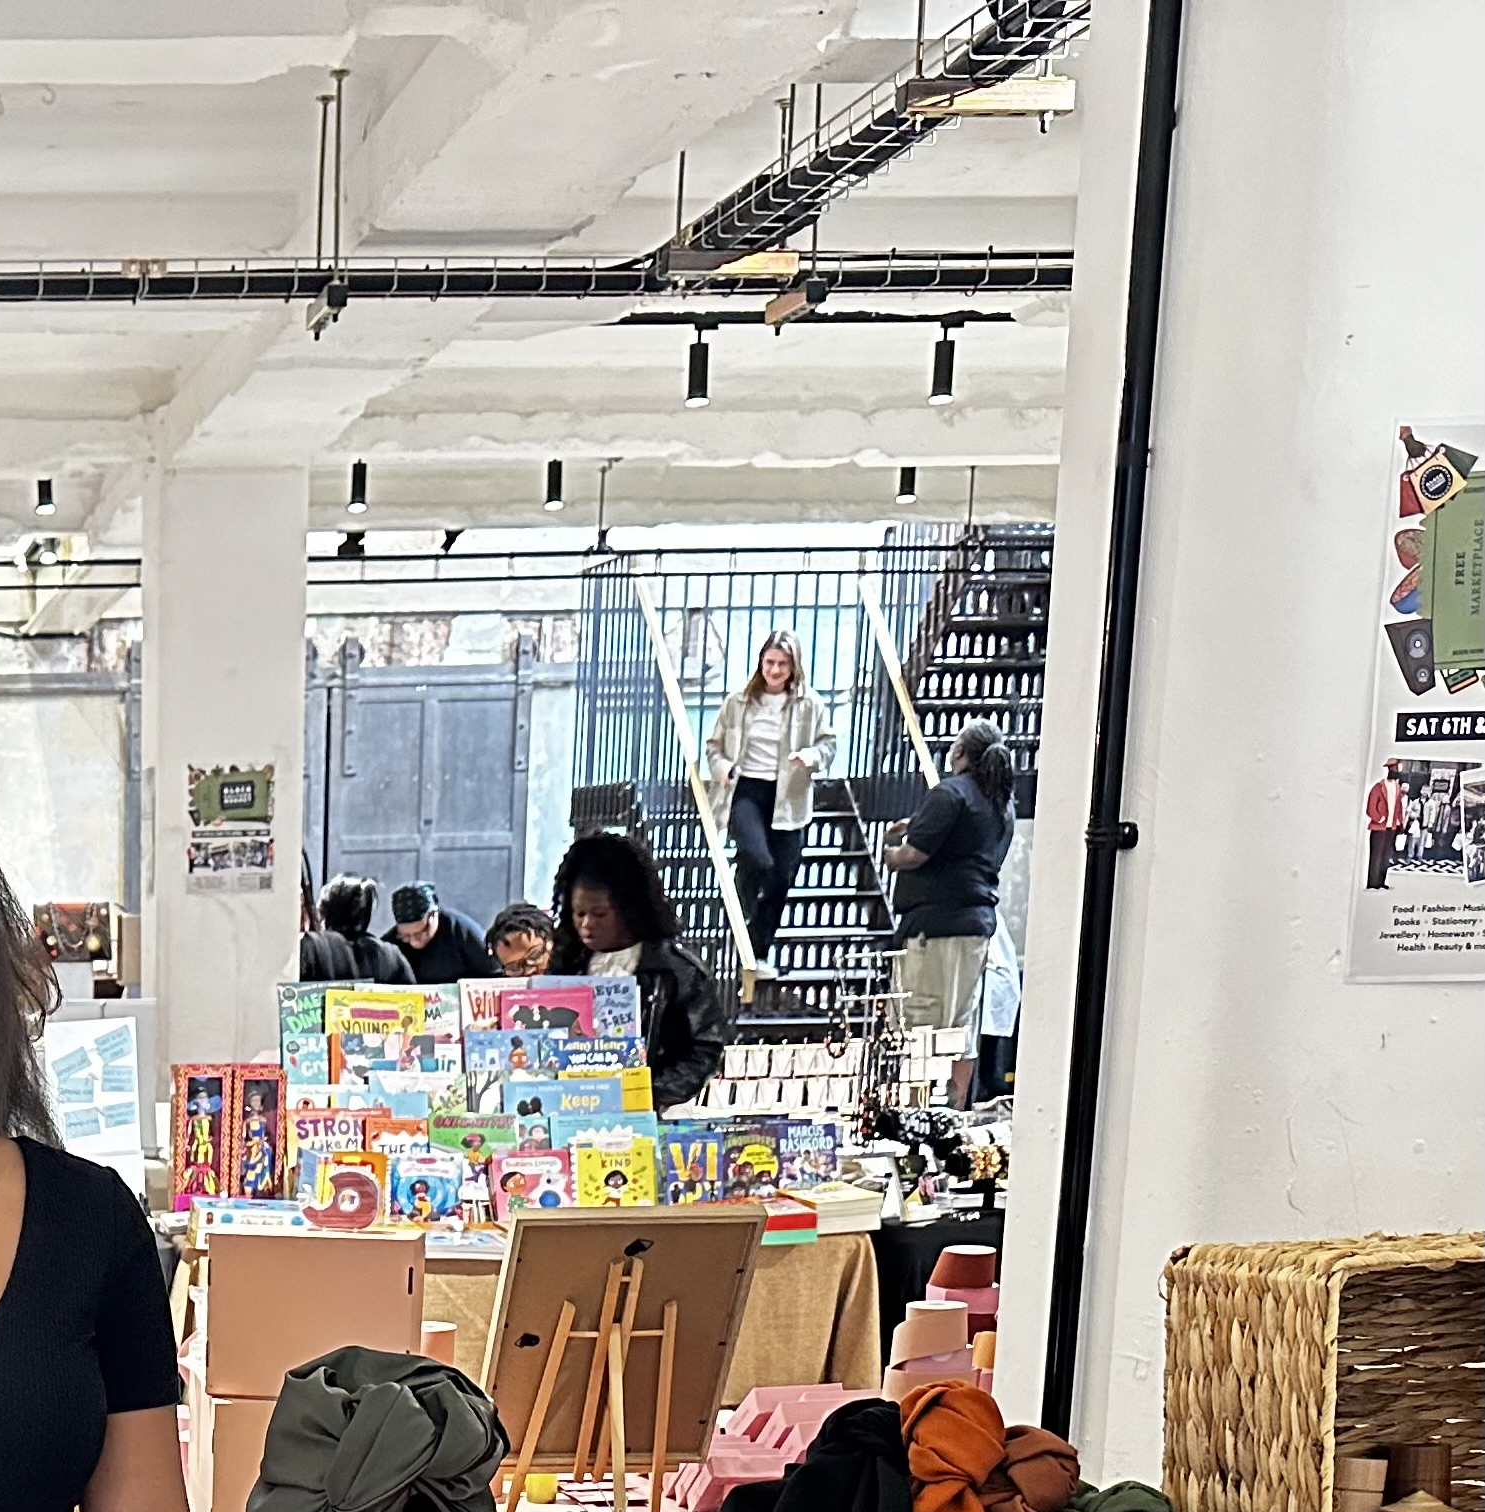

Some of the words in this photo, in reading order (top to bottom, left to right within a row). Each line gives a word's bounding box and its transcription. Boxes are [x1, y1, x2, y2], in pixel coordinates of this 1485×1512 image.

[1455, 551, 1466, 585] FREE
[1469, 518, 1484, 616] MARKETPLACE
[1406, 717, 1439, 736] SAT
[1441, 716, 1472, 735] 6TH
[1393, 904, 1415, 913] Food
[1422, 903, 1456, 913] Fashion
[1394, 918, 1420, 926] Books
[1432, 917, 1477, 927] Stationery
[1379, 930, 1420, 940] Jewellery
[1427, 930, 1475, 938] Homeware
[1397, 943, 1426, 952] Health
[1433, 943, 1463, 952] Beauty
[1466, 942, 1472, 950] &
[341, 1020, 390, 1034] YOUNG
[560, 1093, 600, 1112] Keep
[787, 1125, 825, 1138] MARCUS
[779, 1136, 834, 1153] RASHFORD
[601, 1159, 632, 1169] KIND
